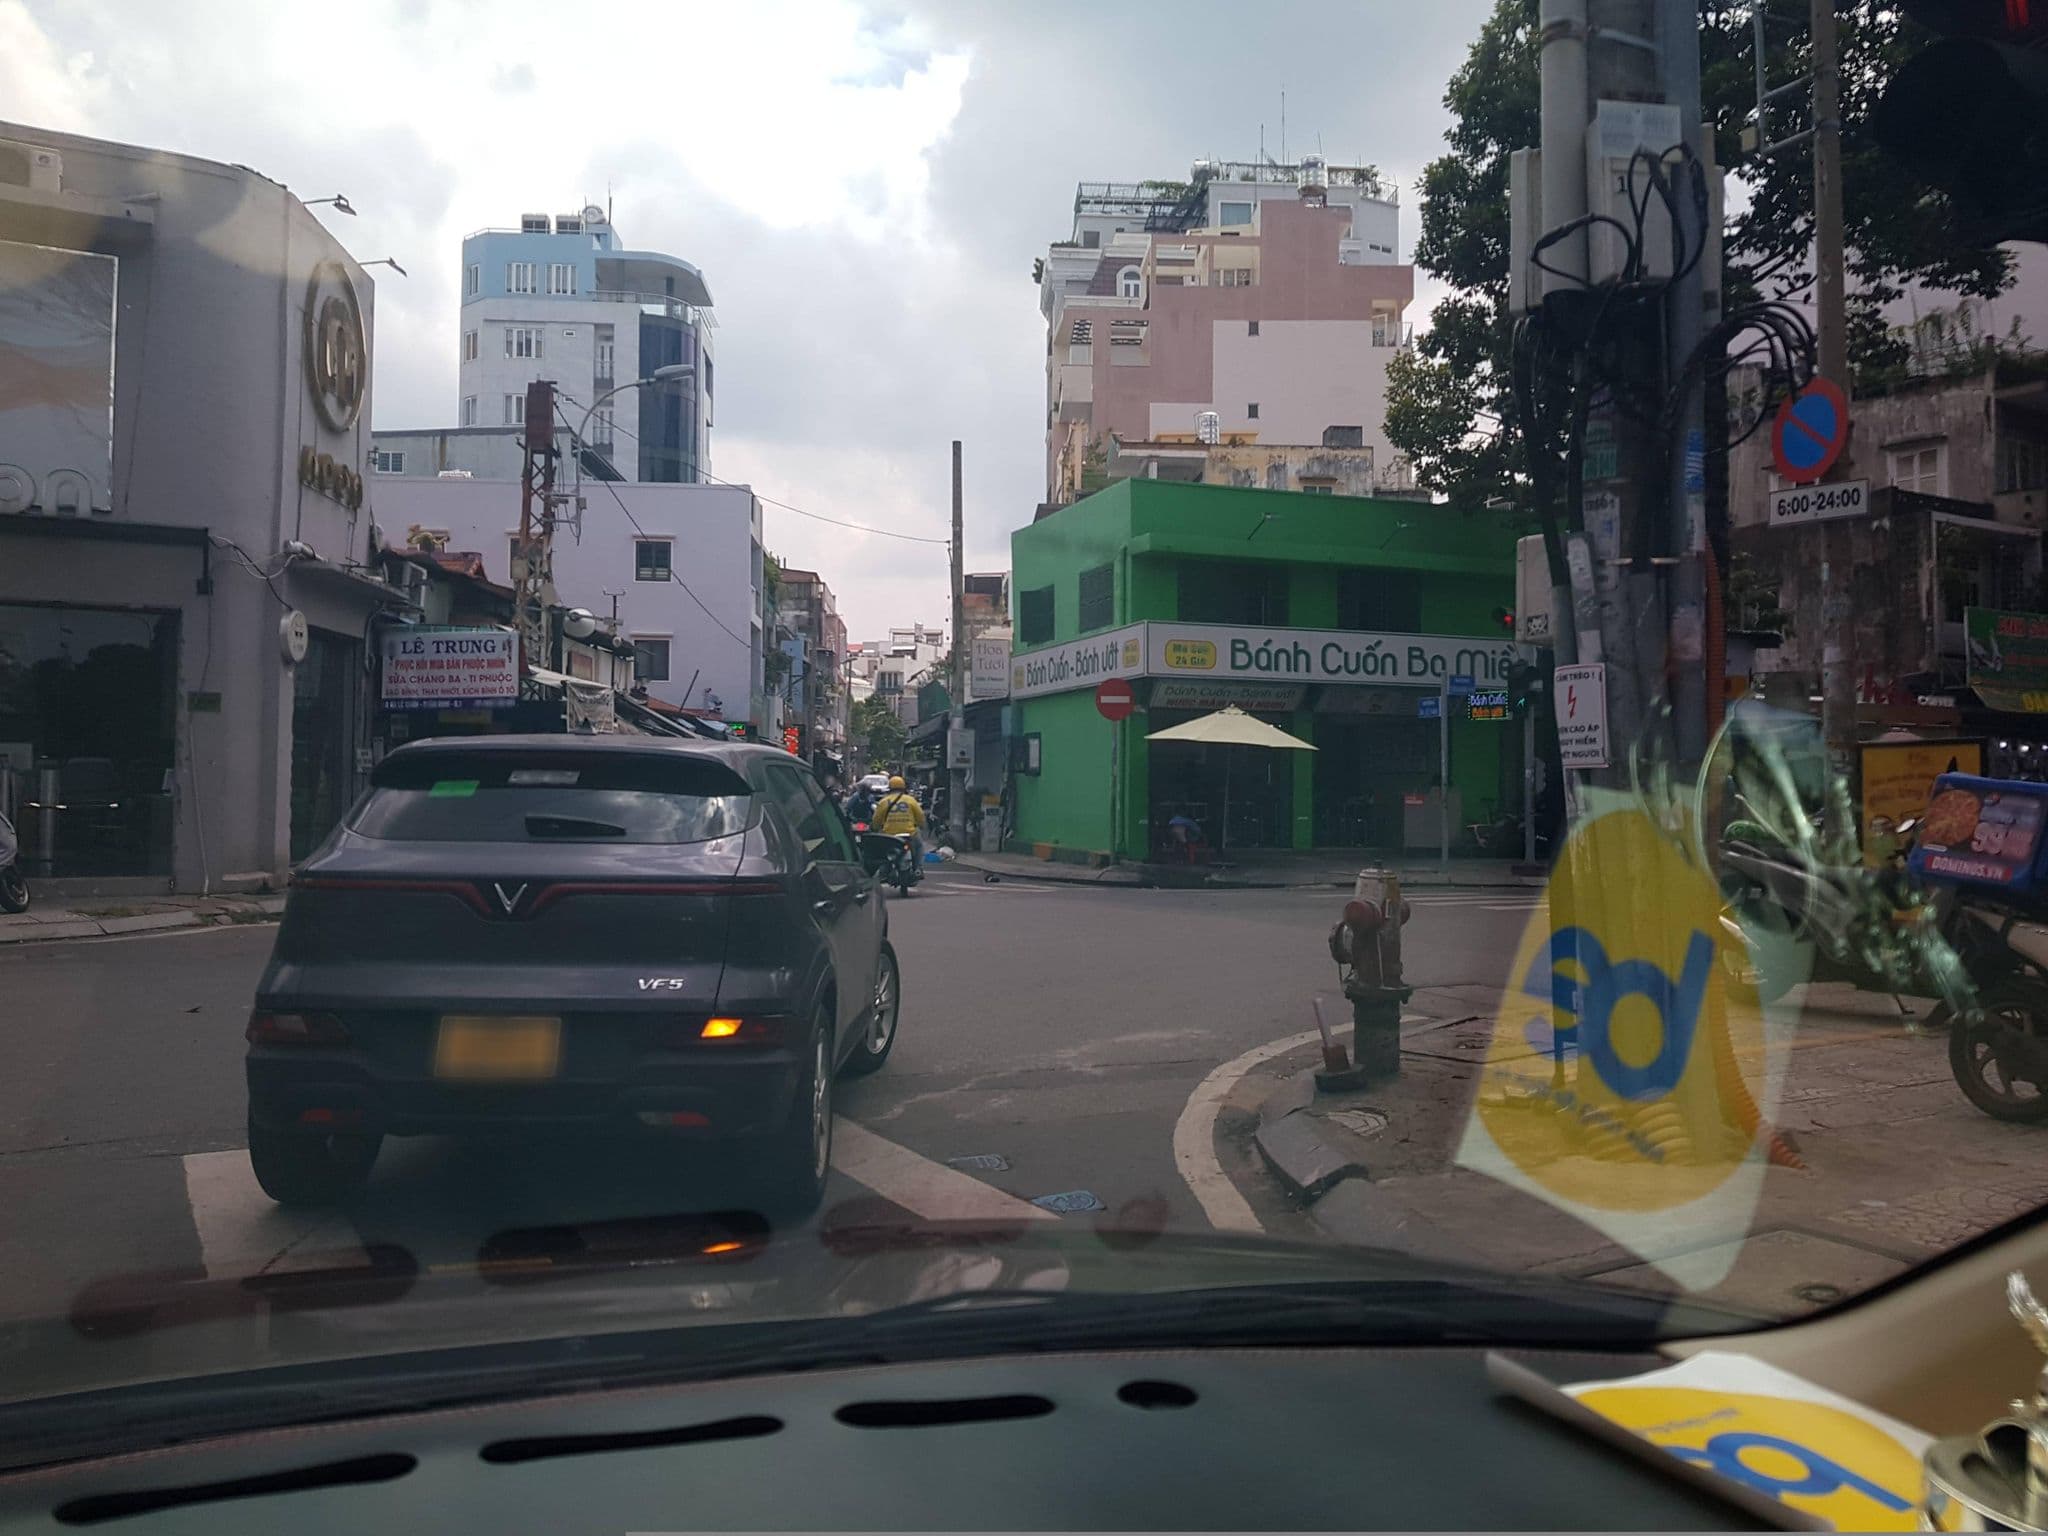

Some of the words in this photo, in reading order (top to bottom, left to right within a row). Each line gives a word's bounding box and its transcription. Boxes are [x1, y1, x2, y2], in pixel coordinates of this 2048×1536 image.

[1777, 488, 1860, 516] 6:00-24:00
[401, 637, 425, 654] LÊ
[432, 639, 496, 654] TRUNG
[1027, 662, 1047, 687] Bánh
[1048, 650, 1070, 682] Cuốn
[1076, 647, 1099, 677] Bánh
[1175, 656, 1187, 666] 24
[1230, 639, 1311, 673] Bánh
[1320, 640, 1399, 677] Cuốn
[1408, 647, 1446, 679] Ba
[1455, 644, 1516, 680] Miề
[448, 674, 461, 683] BA
[1569, 725, 1586, 733] CAO
[638, 978, 684, 991] VF5
